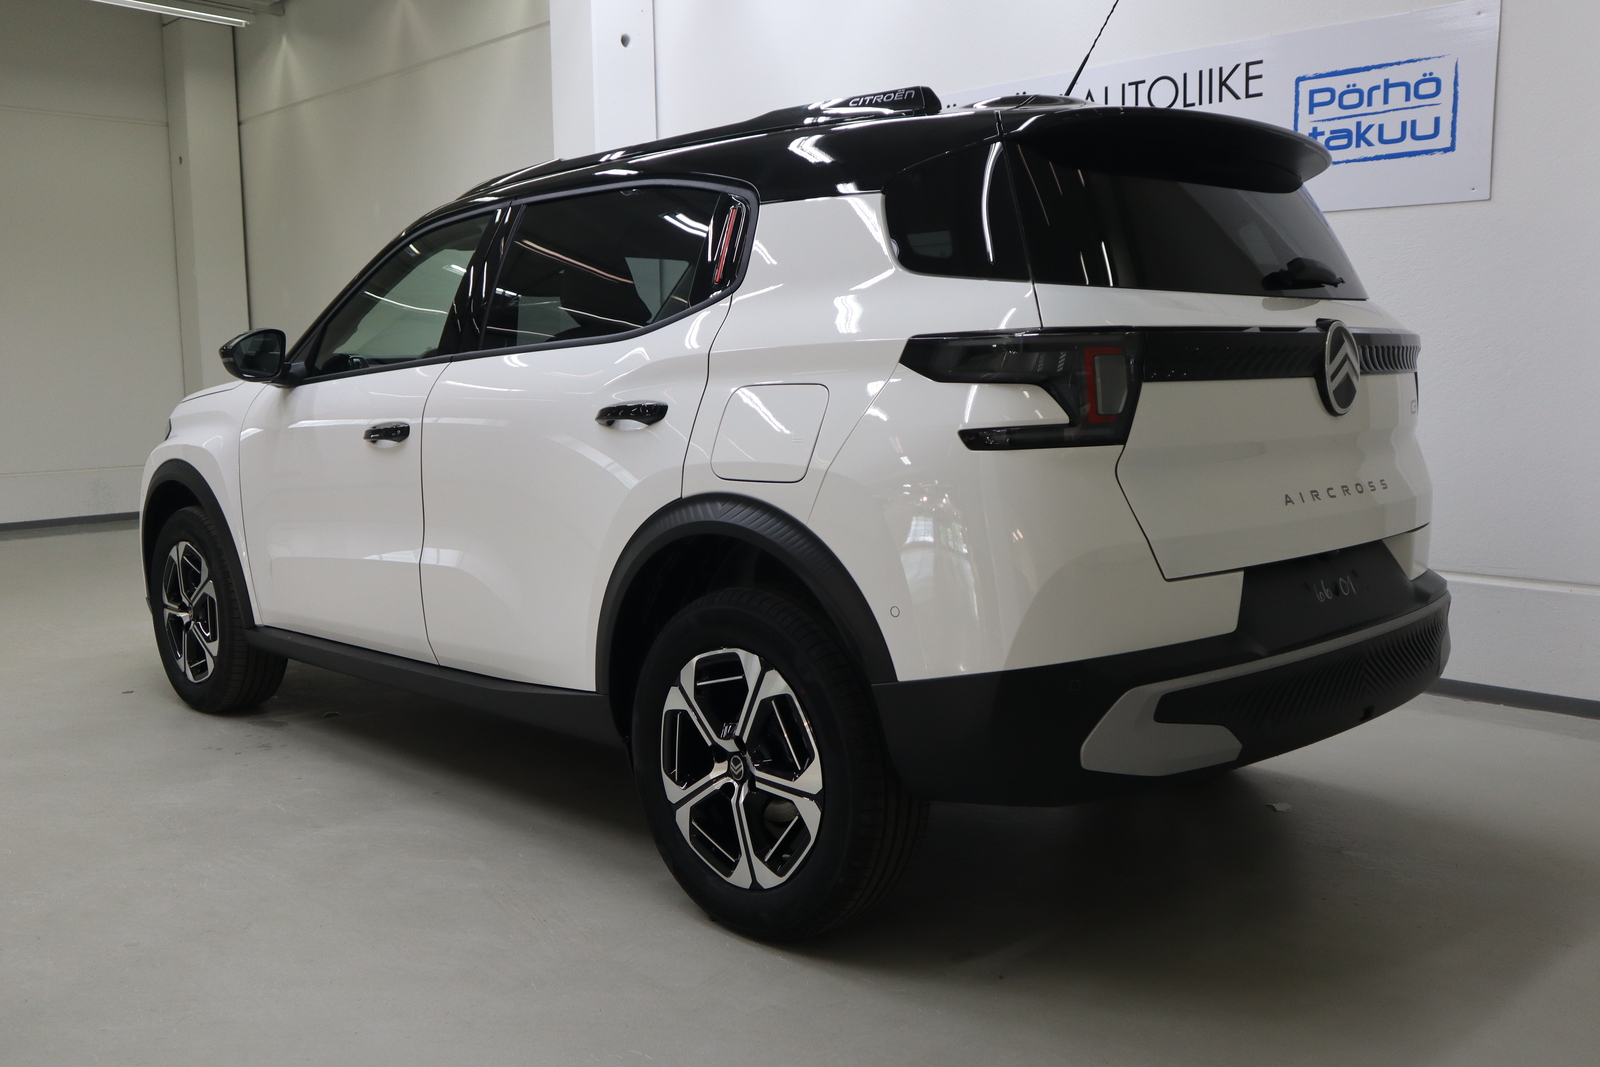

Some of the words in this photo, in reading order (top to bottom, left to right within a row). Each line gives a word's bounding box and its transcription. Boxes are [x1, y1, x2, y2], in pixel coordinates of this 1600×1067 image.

[1308, 71, 1442, 115] Pörhö
[1308, 116, 1441, 151] takuu
[1284, 479, 1388, 506] AIRCROSS
